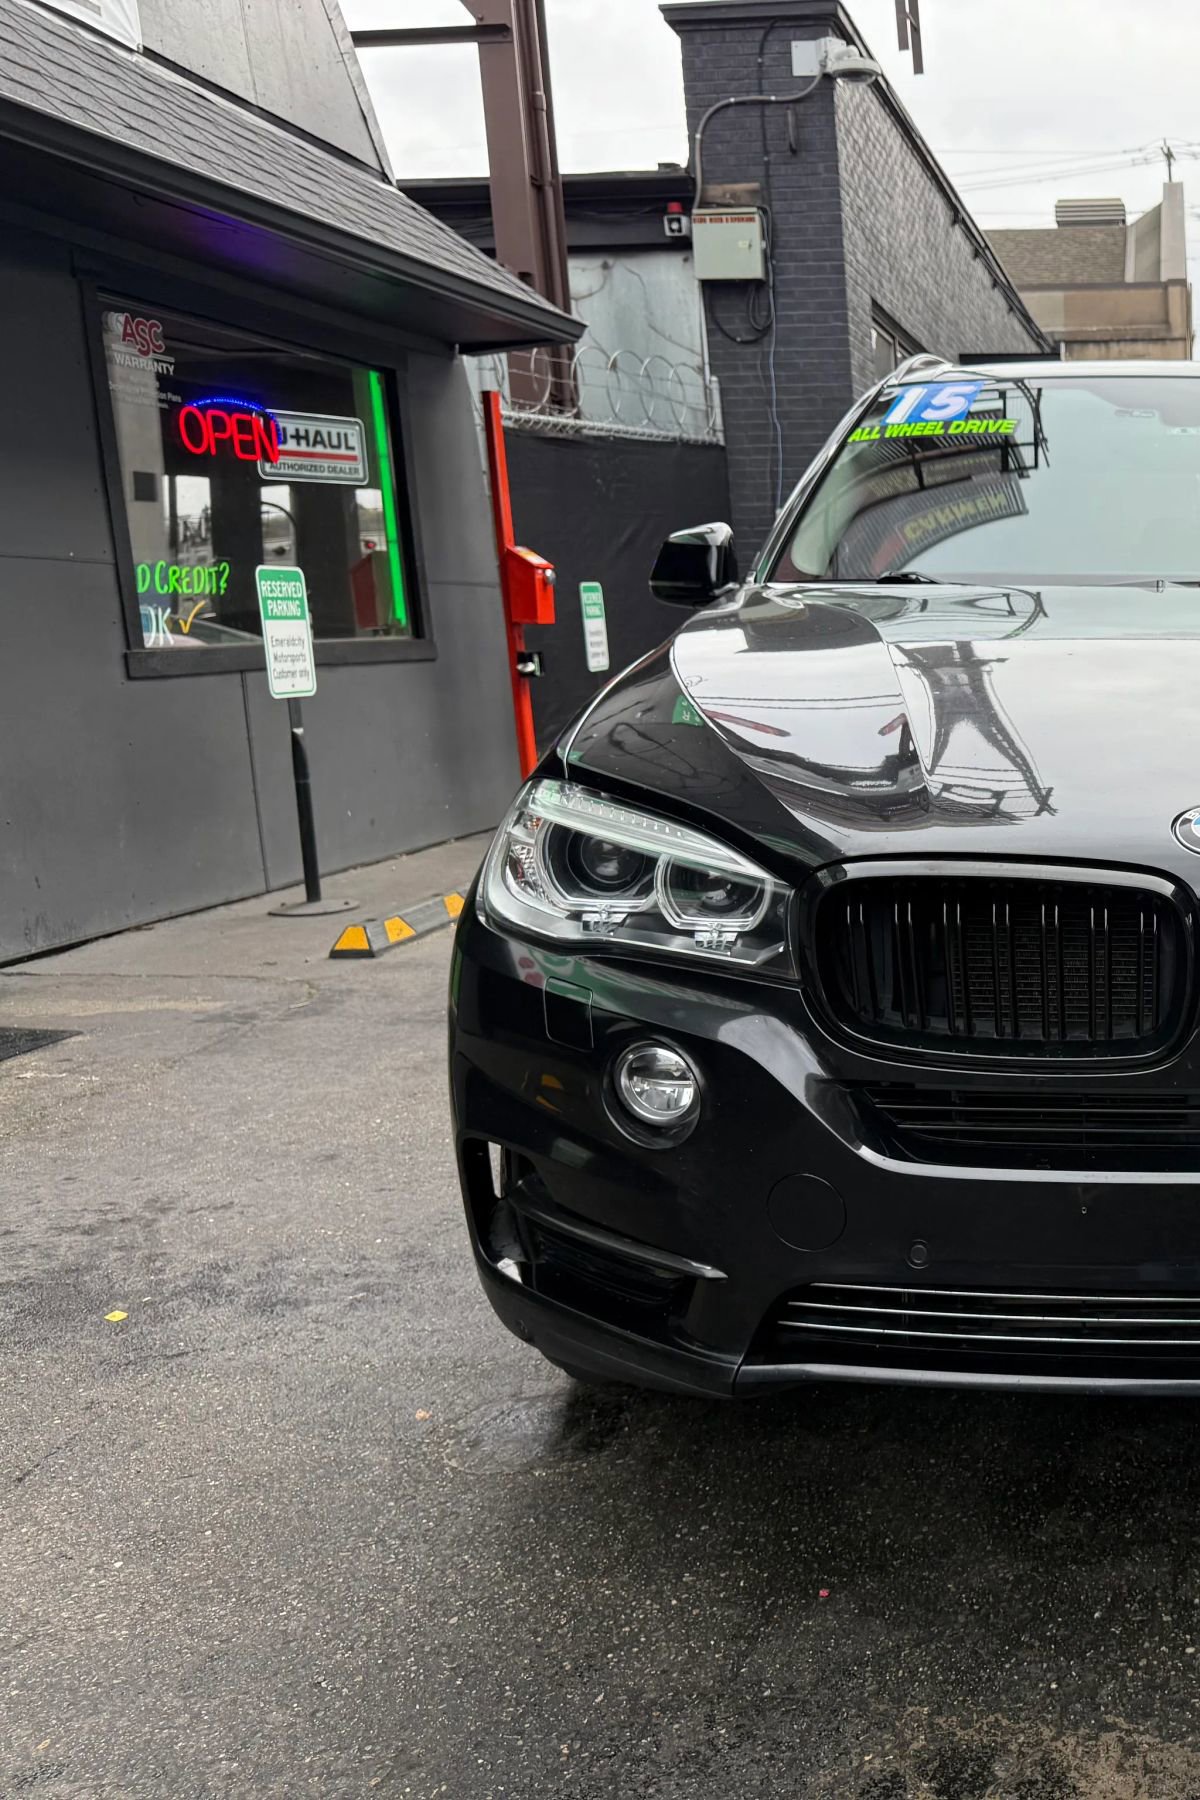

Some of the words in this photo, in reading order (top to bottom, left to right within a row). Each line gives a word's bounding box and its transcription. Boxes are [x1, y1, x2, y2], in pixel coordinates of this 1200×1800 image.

[121, 312, 165, 358] ASC
[113, 353, 175, 375] WARRANTY
[885, 385, 978, 425] 15
[179, 405, 280, 465] OPEN
[848, 426, 880, 443] ALL
[885, 420, 945, 438] WHEEL
[948, 420, 1017, 434] DRIVE
[269, 462, 326, 474] AUTHORIZED
[327, 464, 361, 476] DEALER
[154, 560, 230, 596] CREDIT?
[261, 580, 303, 598] RESERVED
[267, 600, 301, 617] PARKING
